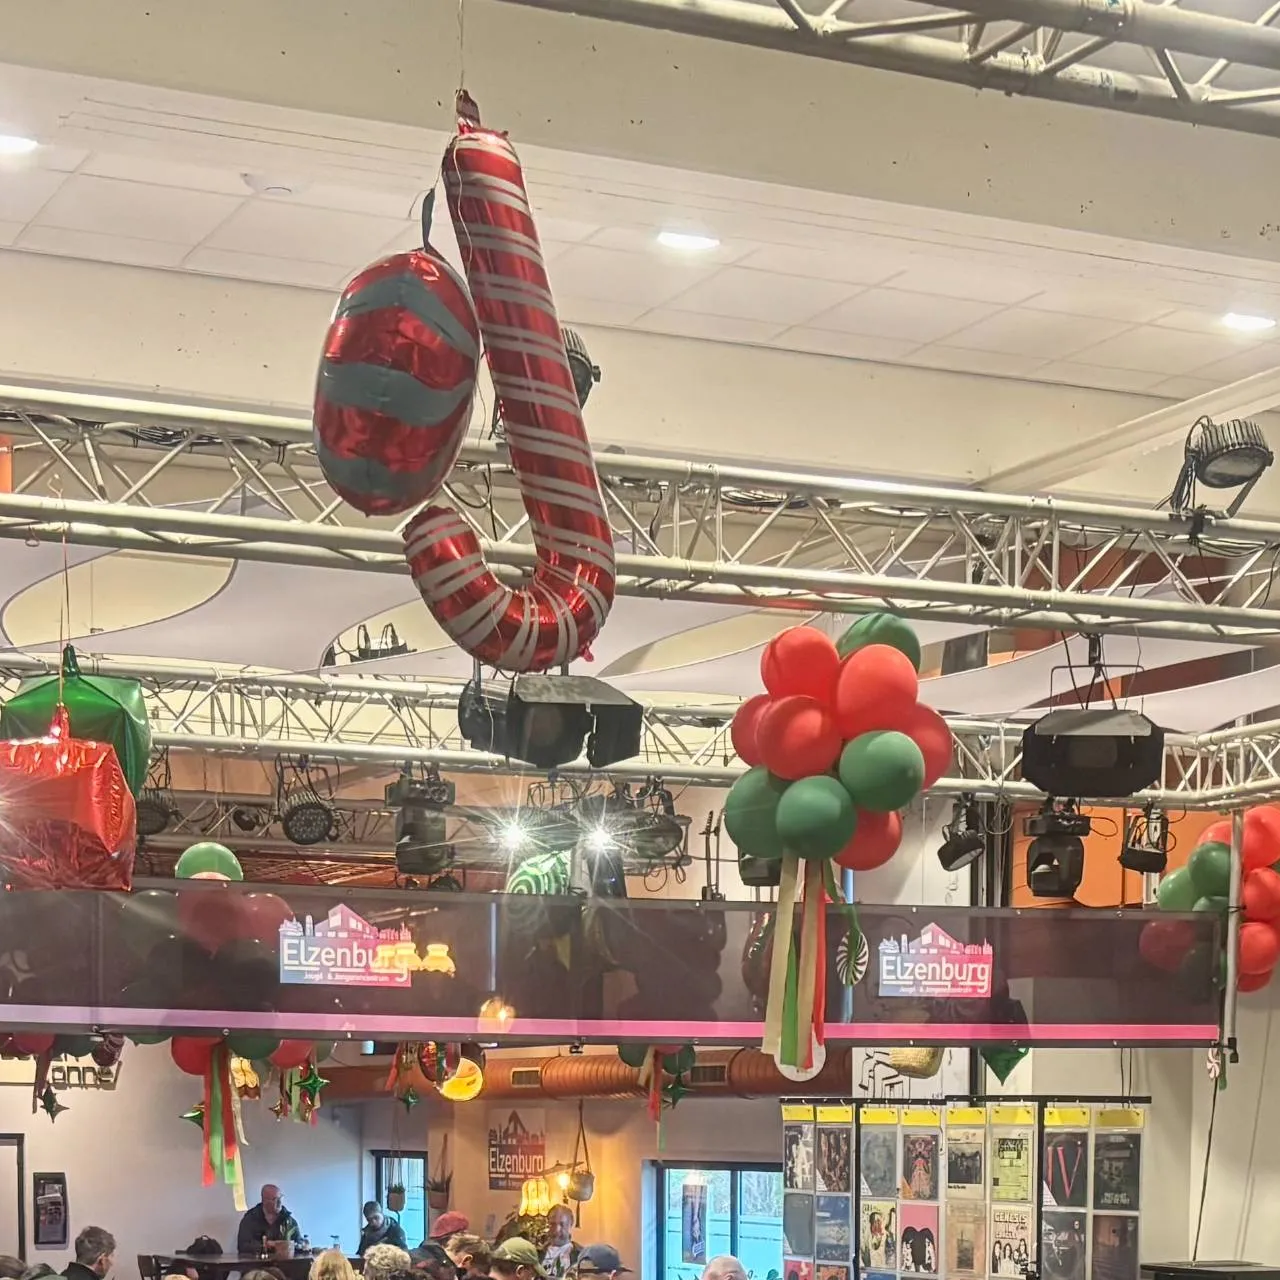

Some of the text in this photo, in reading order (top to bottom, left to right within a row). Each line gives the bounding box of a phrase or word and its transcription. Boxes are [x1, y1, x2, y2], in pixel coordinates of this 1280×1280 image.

[283, 938, 409, 982] Elzenburg
[882, 956, 990, 993] Elzenburg
[489, 1147, 544, 1177] Elzenburg
